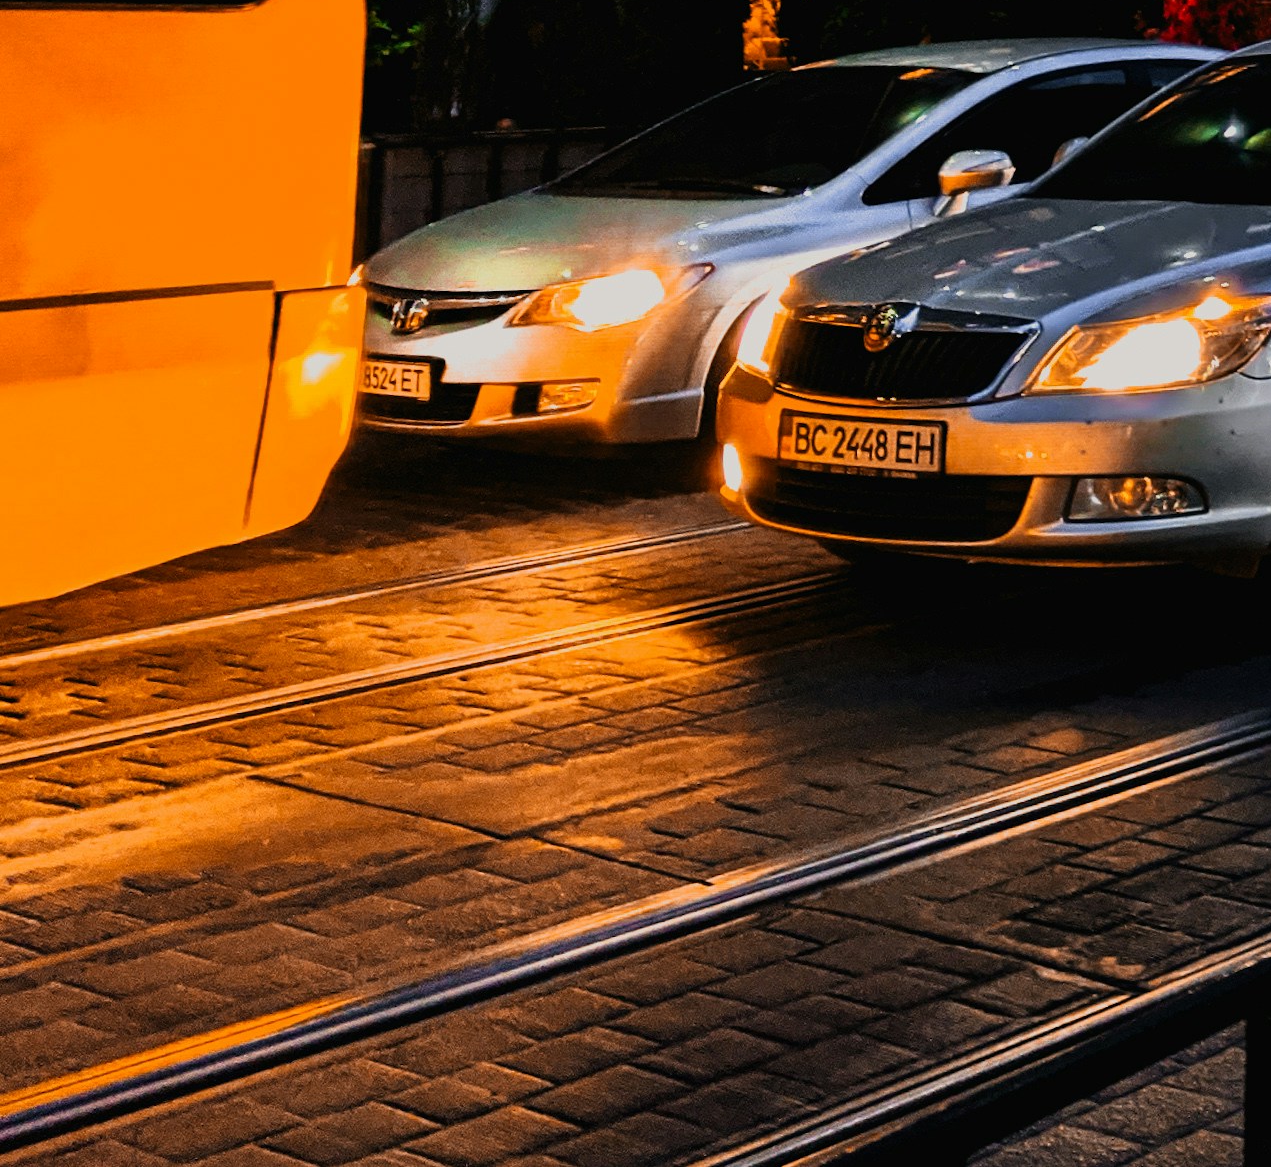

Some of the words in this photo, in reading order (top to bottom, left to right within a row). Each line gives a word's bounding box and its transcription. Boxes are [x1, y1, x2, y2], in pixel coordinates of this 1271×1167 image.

[795, 422, 828, 456] BC
[832, 426, 889, 462] 2448
[895, 430, 936, 466] EH
